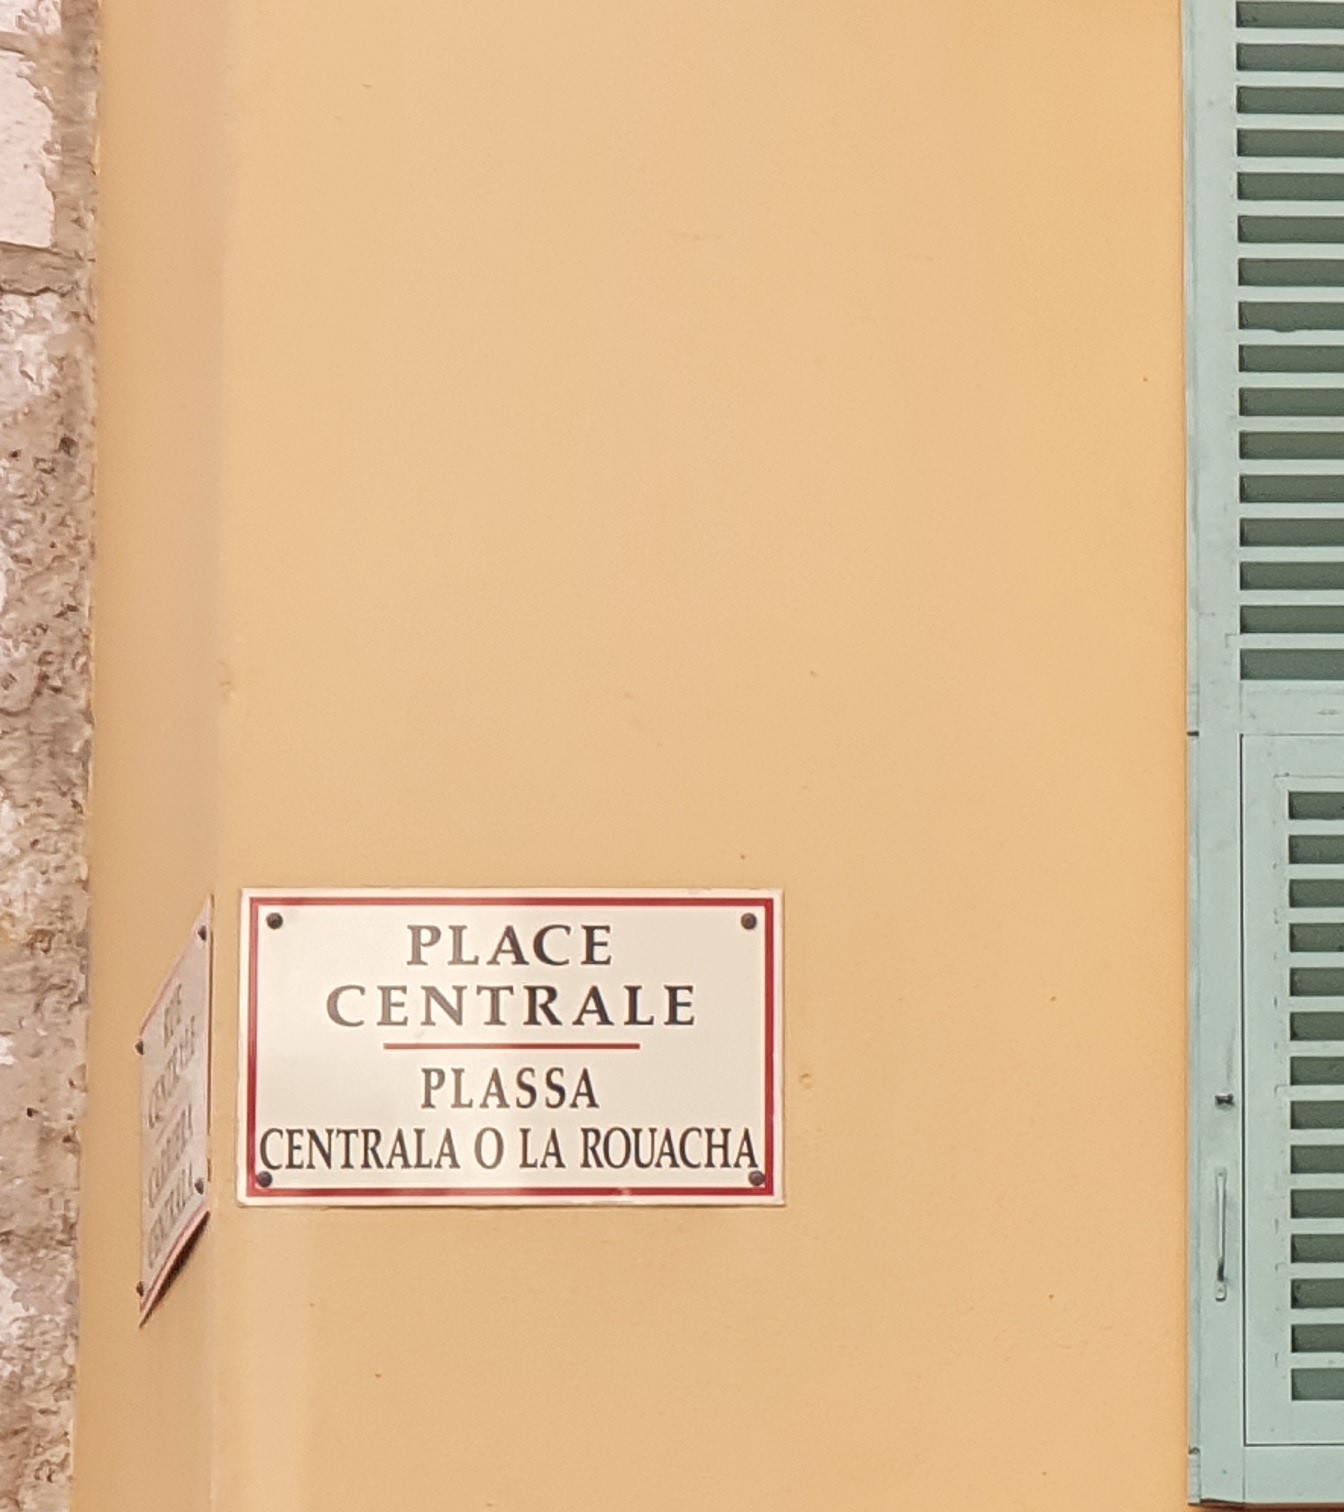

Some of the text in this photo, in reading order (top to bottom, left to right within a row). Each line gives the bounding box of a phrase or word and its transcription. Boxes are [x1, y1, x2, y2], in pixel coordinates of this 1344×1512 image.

[406, 924, 613, 966] PLACE
[326, 982, 697, 1028] CENTRALE
[421, 1066, 600, 1109] PLASSA
[259, 1126, 759, 1170] CENTRALA O LA ROUACHA
